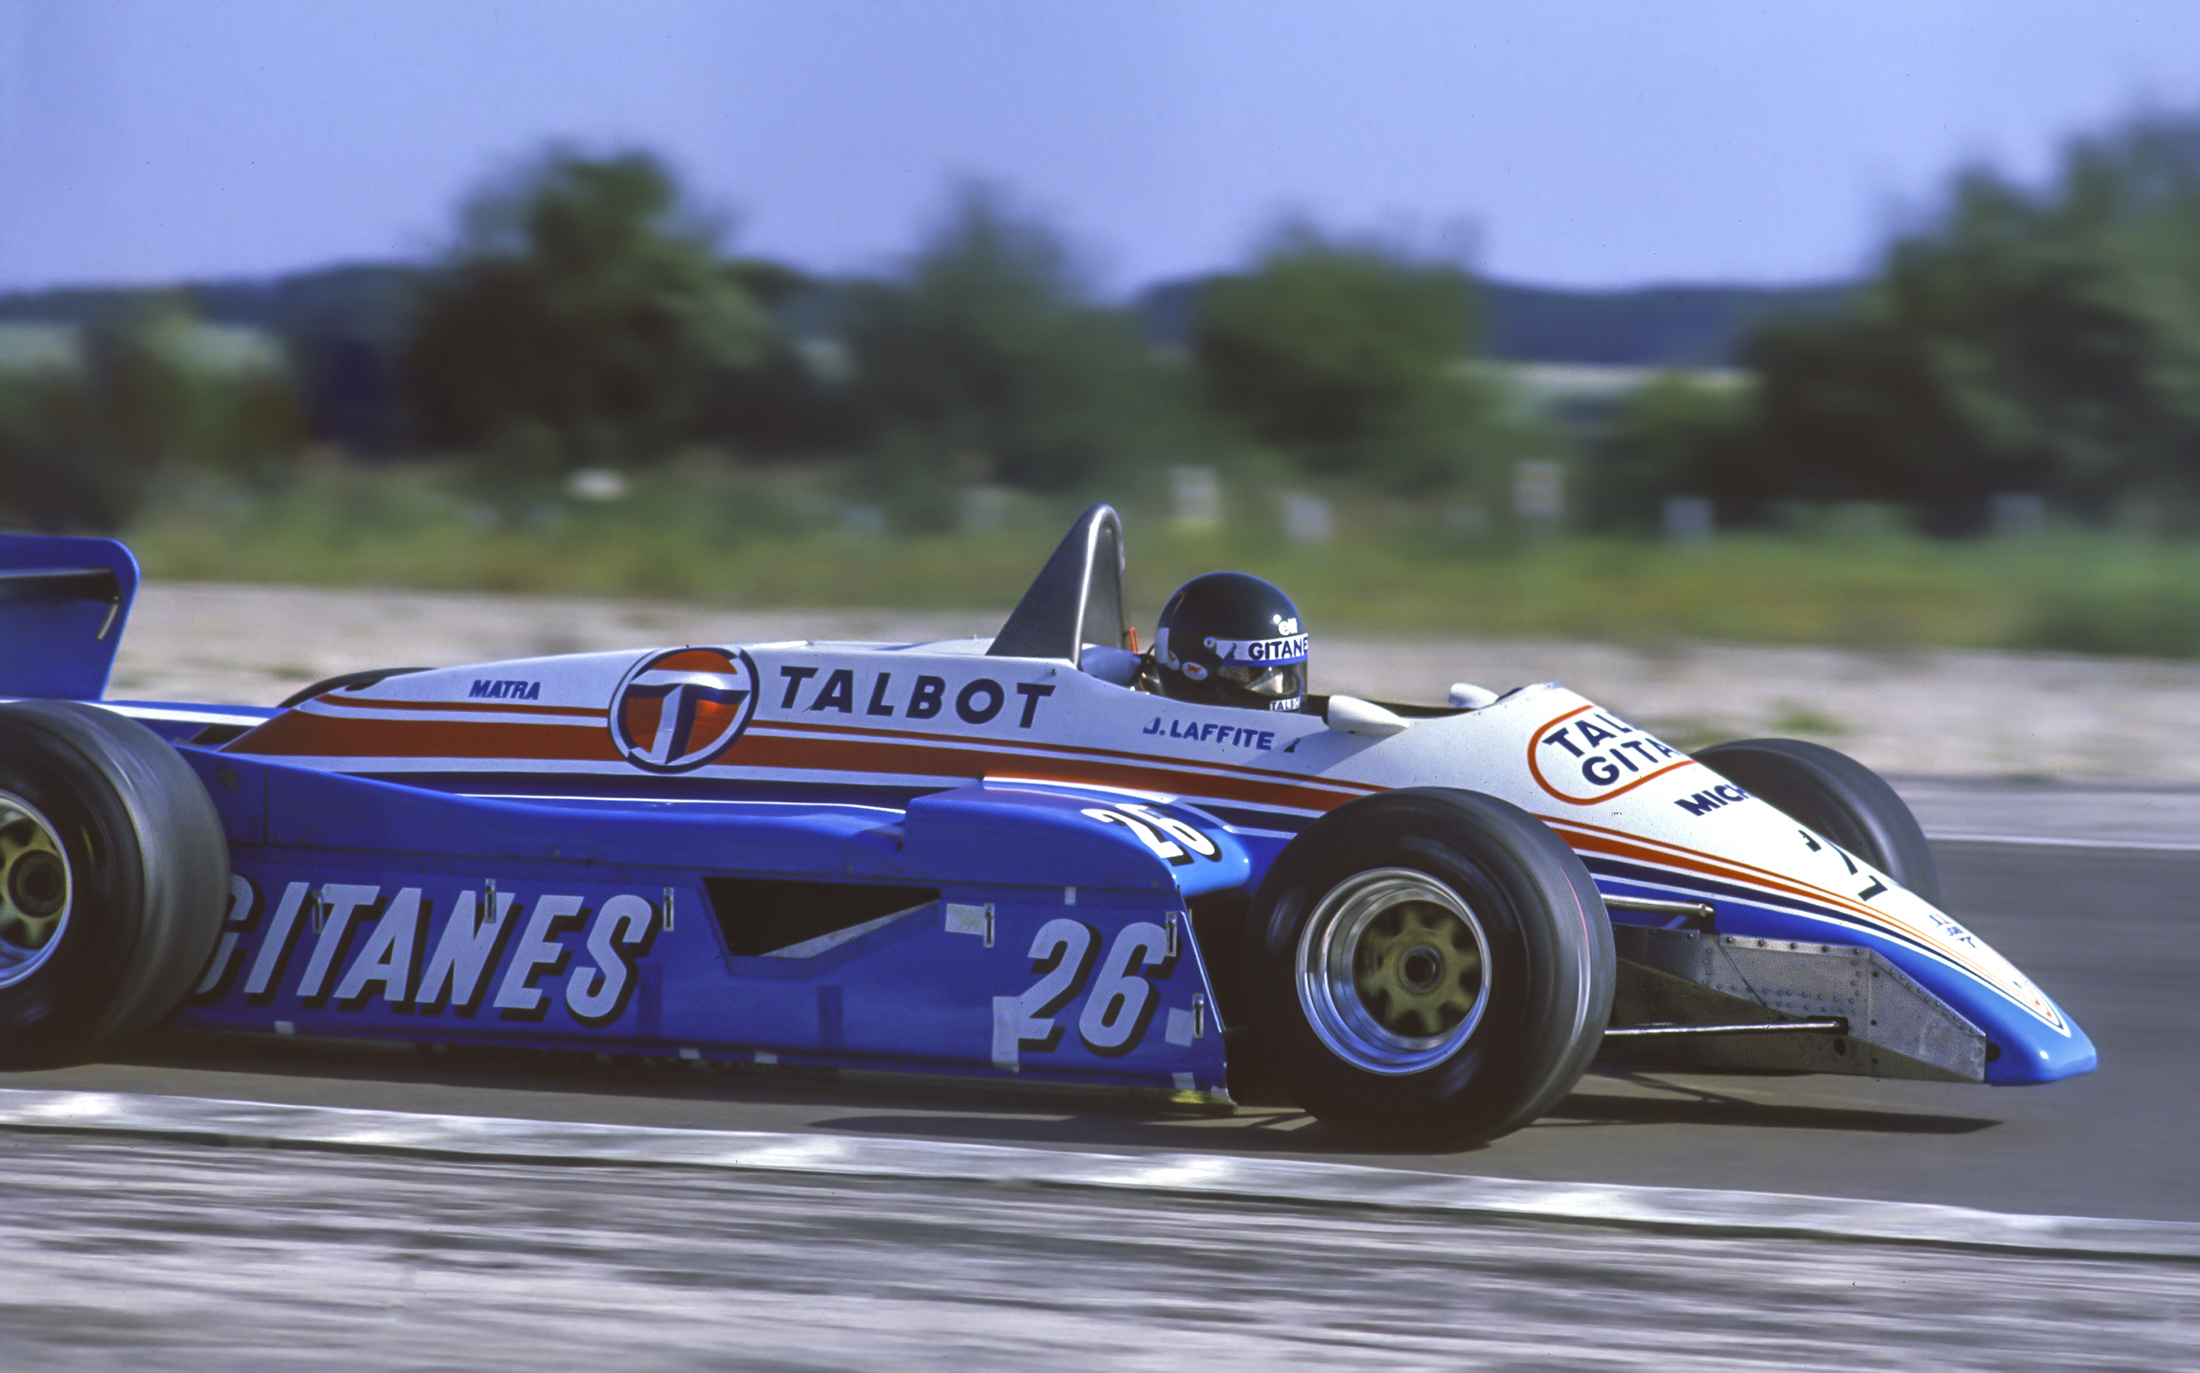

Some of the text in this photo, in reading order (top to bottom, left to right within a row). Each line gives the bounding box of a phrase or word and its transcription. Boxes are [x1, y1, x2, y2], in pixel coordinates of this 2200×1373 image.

[469, 679, 540, 701] MATRA
[779, 665, 1056, 729] TALBOT
[1080, 802, 1223, 867] 26
[1012, 917, 1184, 1058] 26
